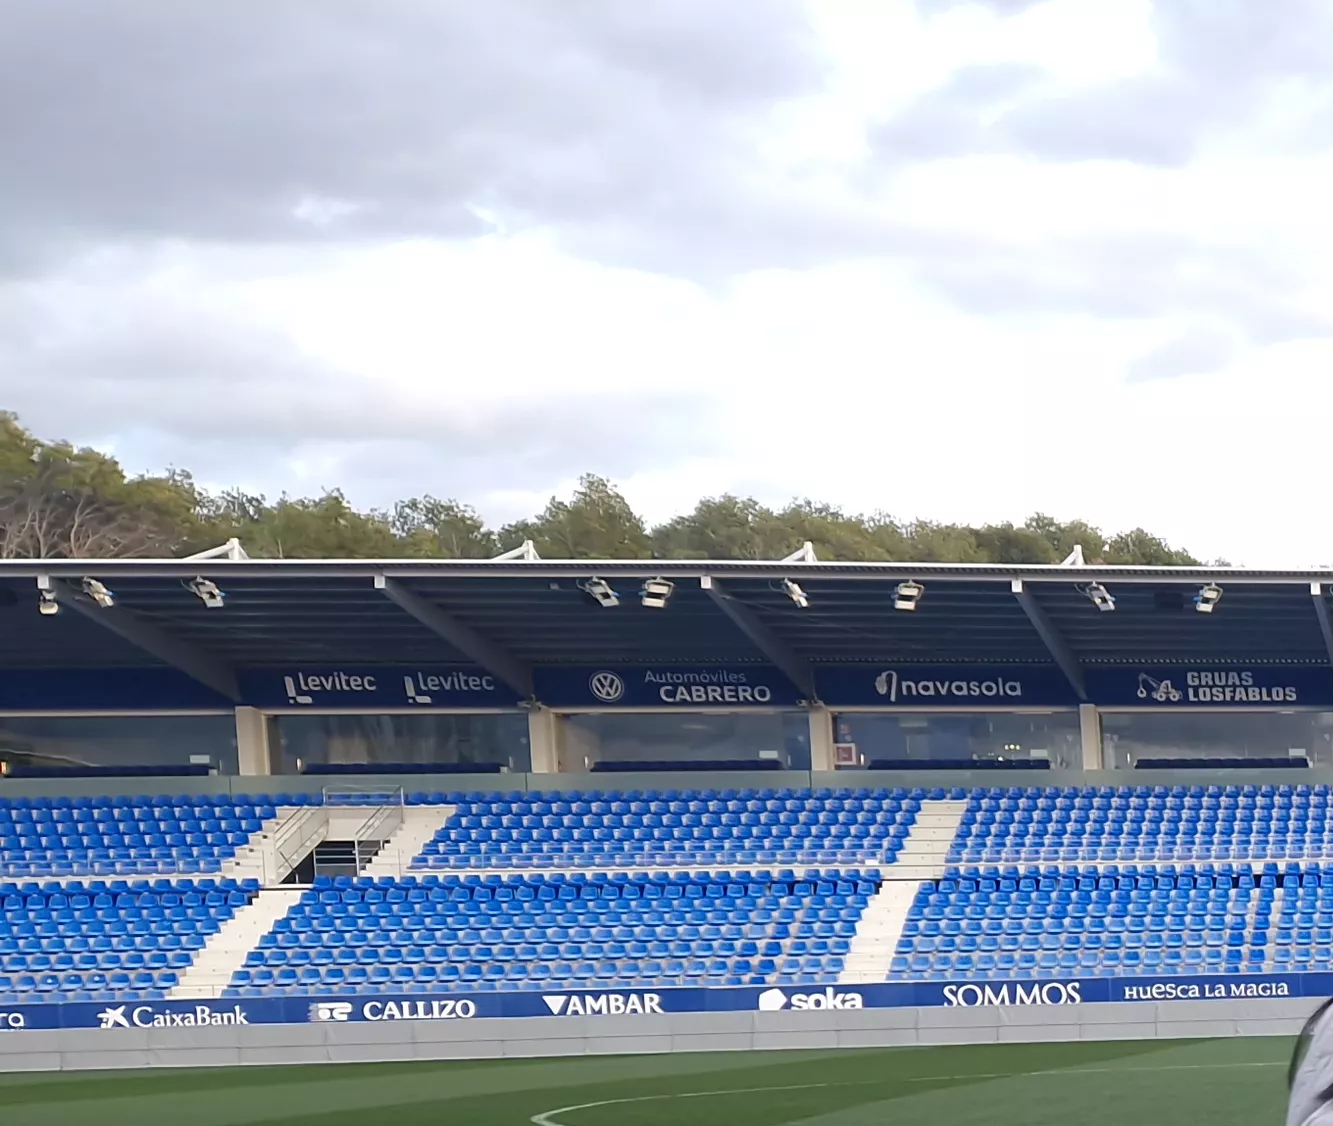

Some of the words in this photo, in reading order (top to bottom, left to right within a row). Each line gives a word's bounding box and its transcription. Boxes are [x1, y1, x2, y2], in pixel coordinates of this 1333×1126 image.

[644, 670, 747, 683] Automóviles
[901, 676, 1022, 697] navasola
[1186, 671, 1254, 686] GRUAS
[659, 685, 771, 702] CABRERO
[1188, 686, 1297, 702] LOSFABLOS
[566, 993, 665, 1016] AMBAR
[789, 986, 863, 1010] soka
[943, 981, 1081, 1008] SOMMOS
[132, 1005, 249, 1028] CaixaBank
[363, 999, 476, 1021] CALLIZO
